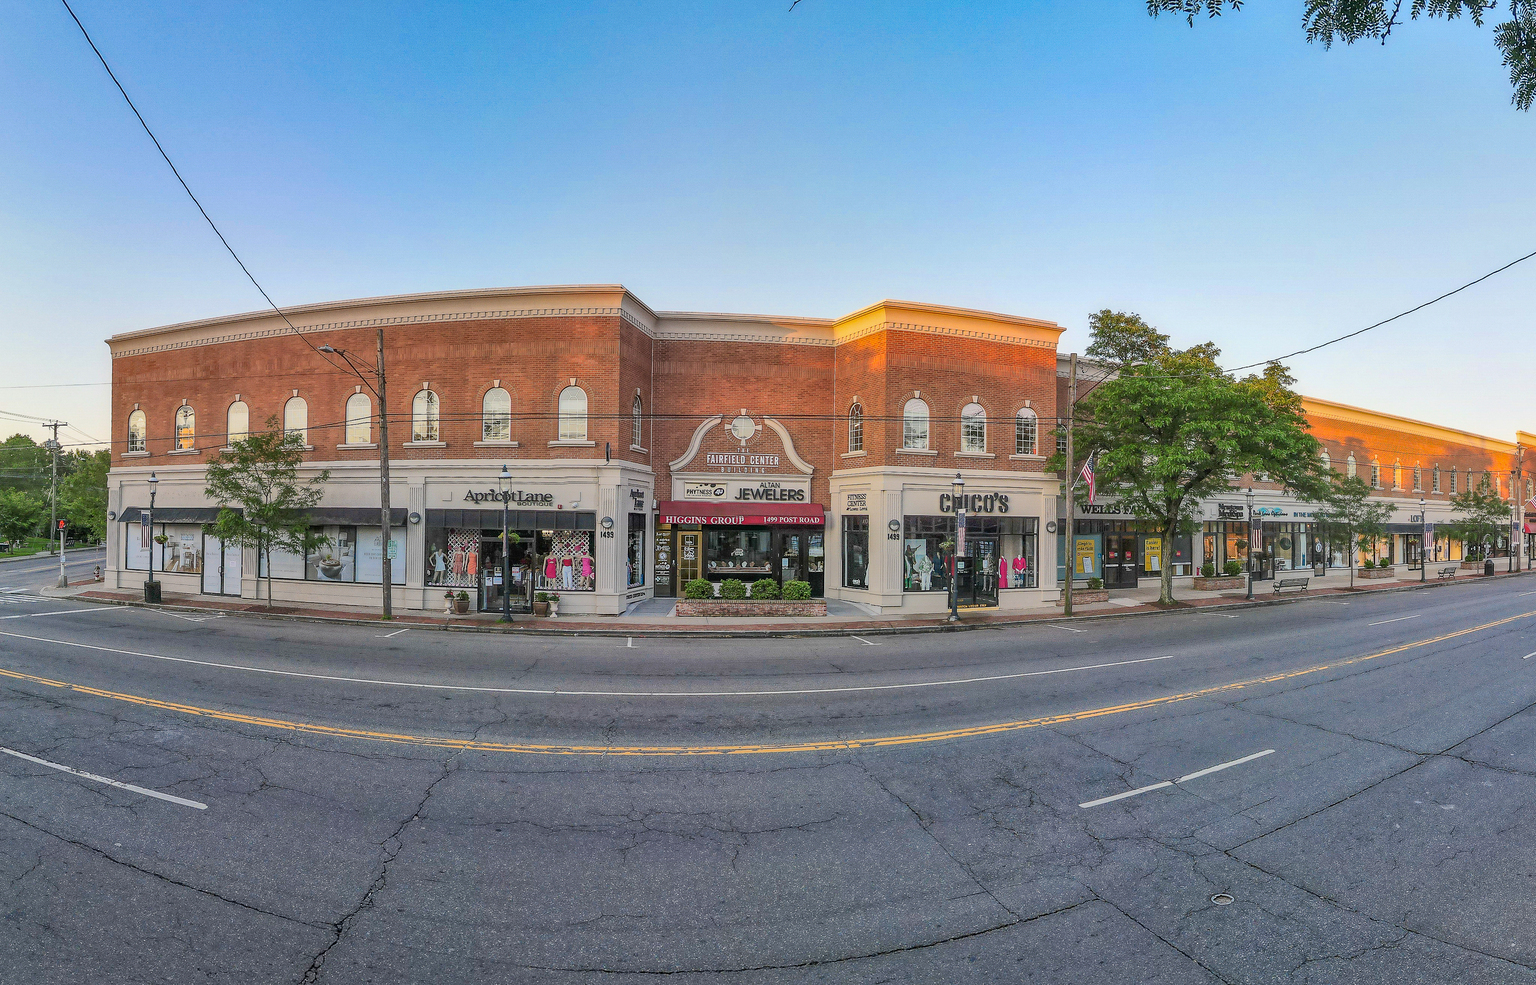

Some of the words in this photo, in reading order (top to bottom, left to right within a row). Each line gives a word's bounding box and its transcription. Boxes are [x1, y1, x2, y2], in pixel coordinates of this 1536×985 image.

[706, 454, 746, 464] FAIRFIELD
[750, 455, 779, 465] CENTER
[463, 489, 517, 504] Apricot
[517, 490, 553, 502] Lane
[735, 488, 805, 501] JEWELERS
[665, 515, 707, 524] HIGGINS
[710, 515, 745, 525] GROUP
[763, 516, 778, 524] 1499
[800, 516, 820, 524] ROAD
